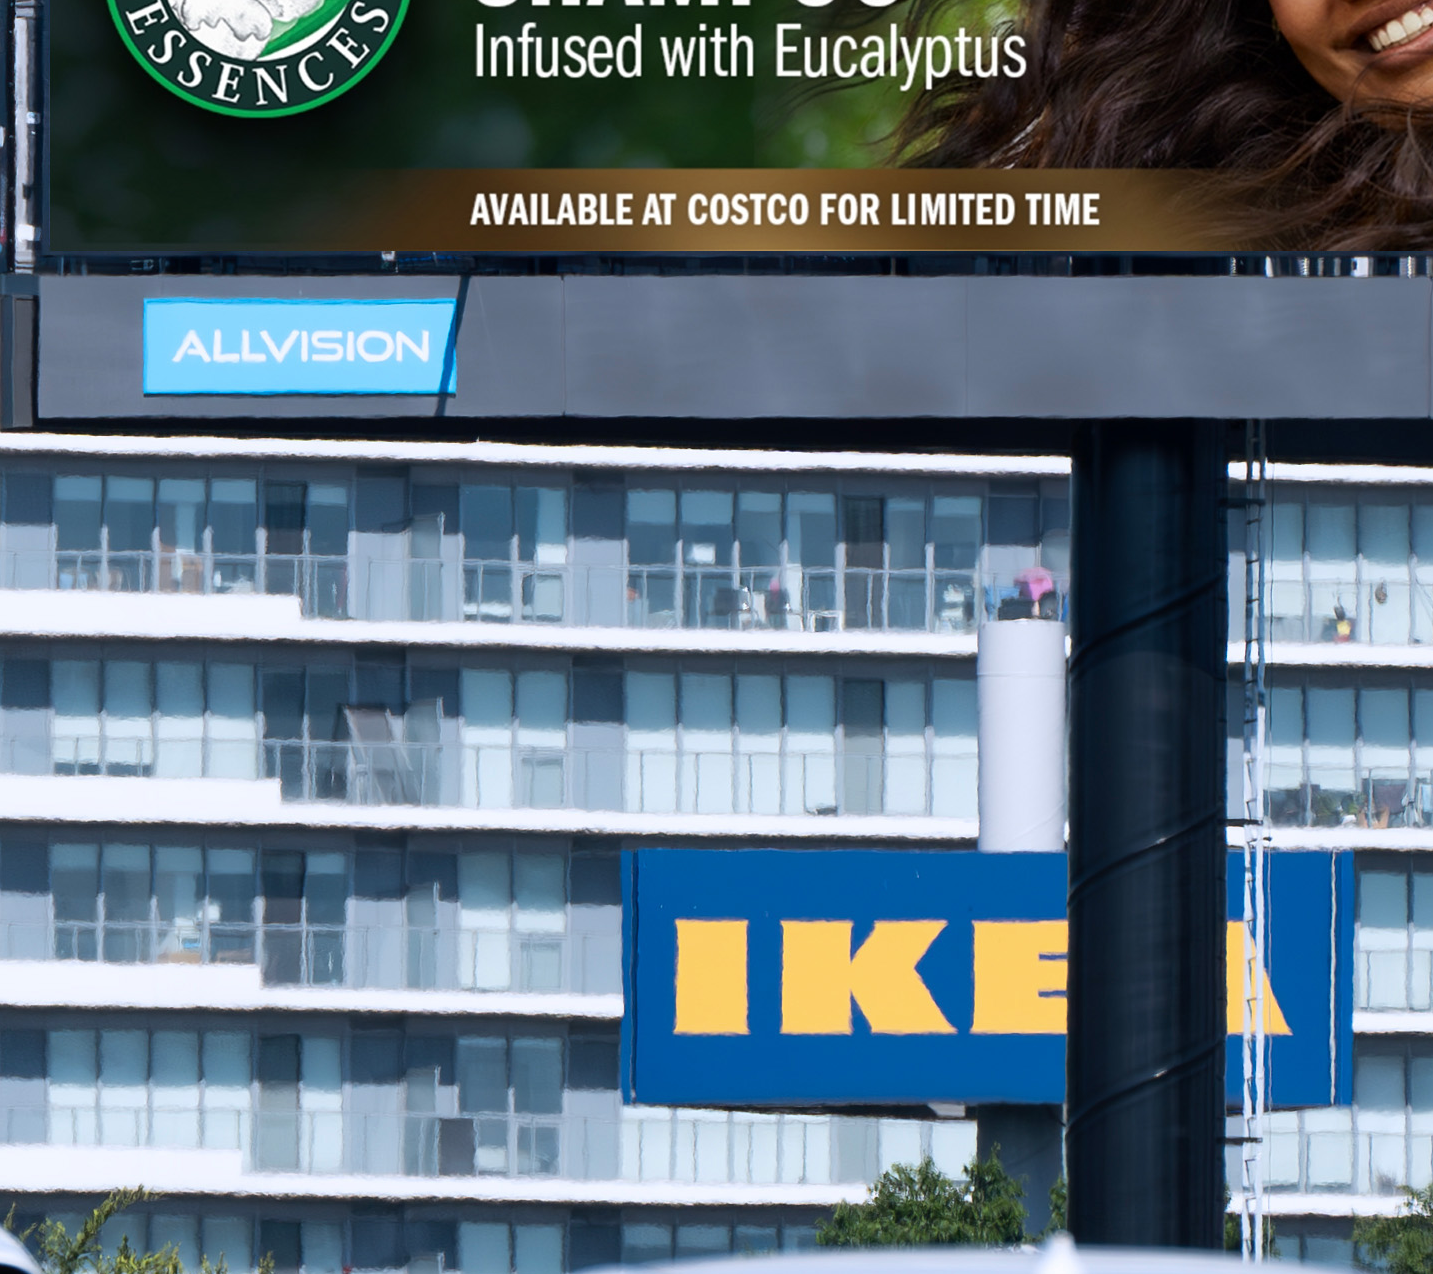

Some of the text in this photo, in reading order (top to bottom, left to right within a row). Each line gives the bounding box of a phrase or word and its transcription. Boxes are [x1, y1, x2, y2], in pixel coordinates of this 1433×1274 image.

[476, 22, 1027, 91] Infused with Eucalyptus
[470, 193, 1100, 226] AVAILABLE AT COSTCO FOR LIMITED TIME
[172, 329, 430, 363] ALLVISION
